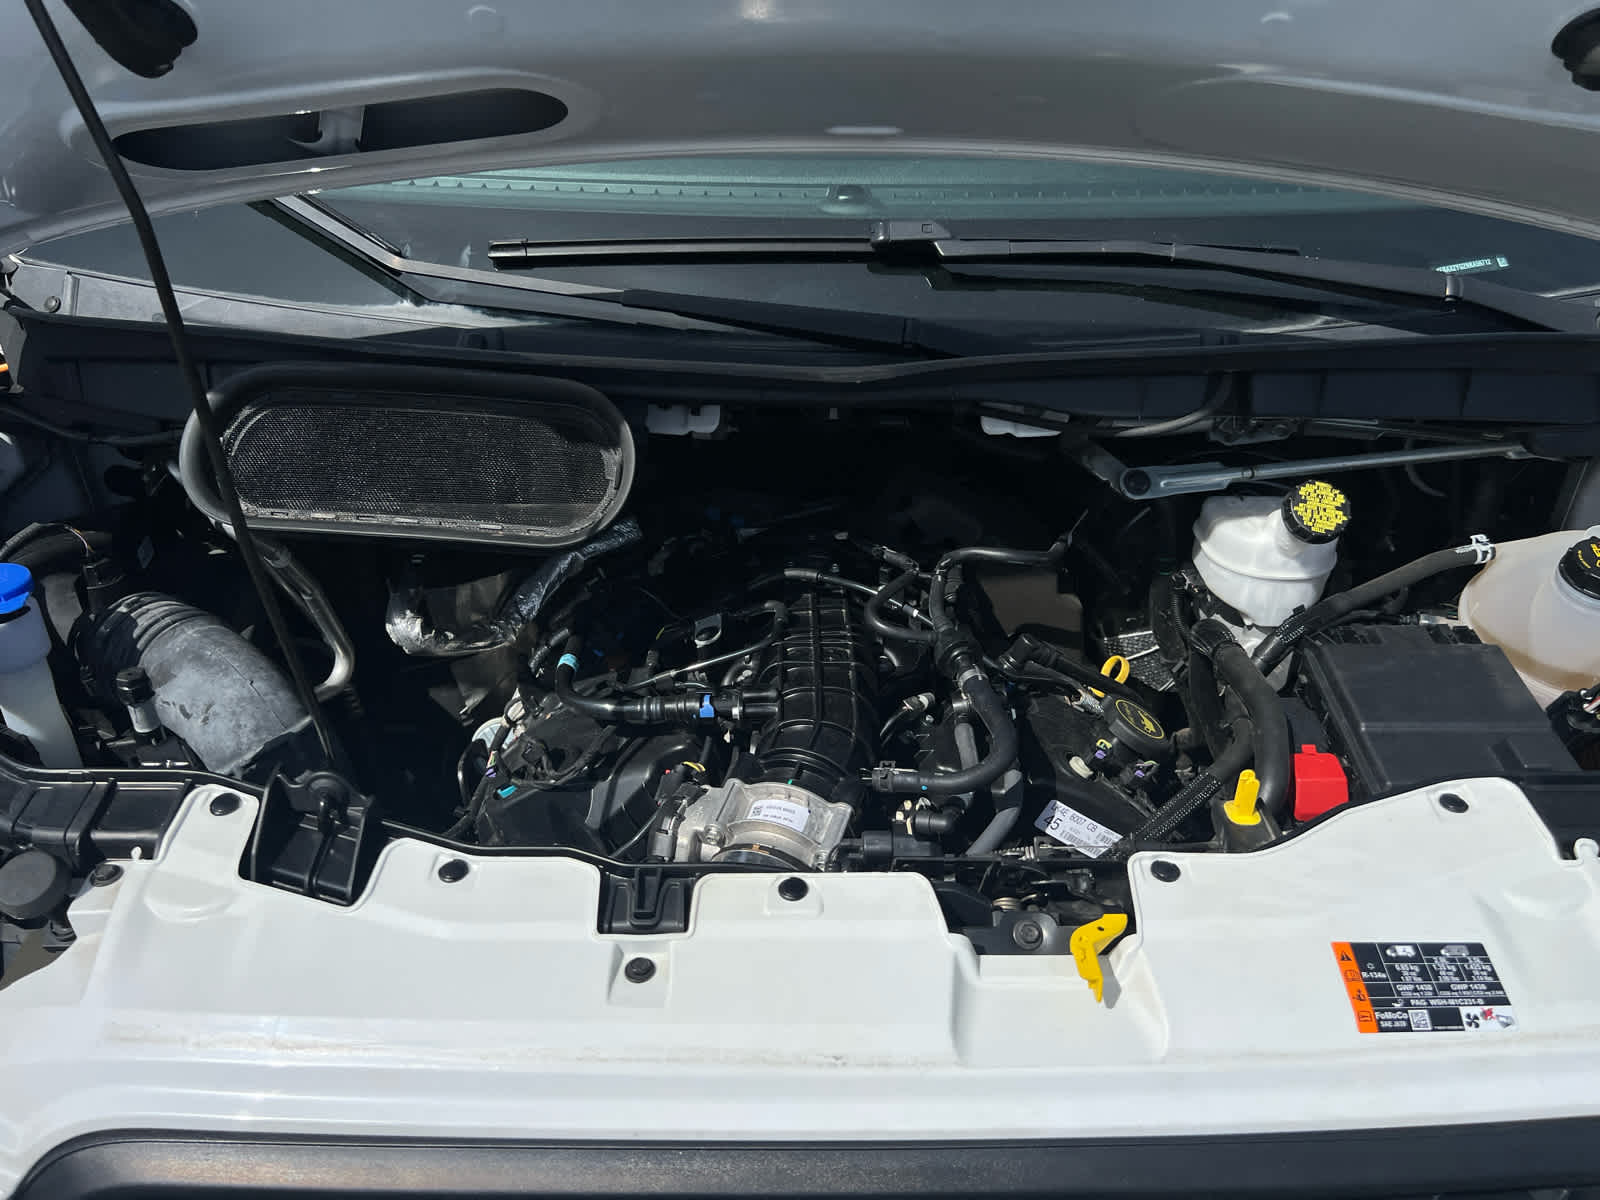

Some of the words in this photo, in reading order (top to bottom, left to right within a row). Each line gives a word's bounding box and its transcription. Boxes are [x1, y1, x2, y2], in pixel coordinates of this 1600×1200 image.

[1043, 815, 1064, 831] 45
[1069, 812, 1087, 826] 6007
[1375, 1011, 1409, 1020] FoMoCo
